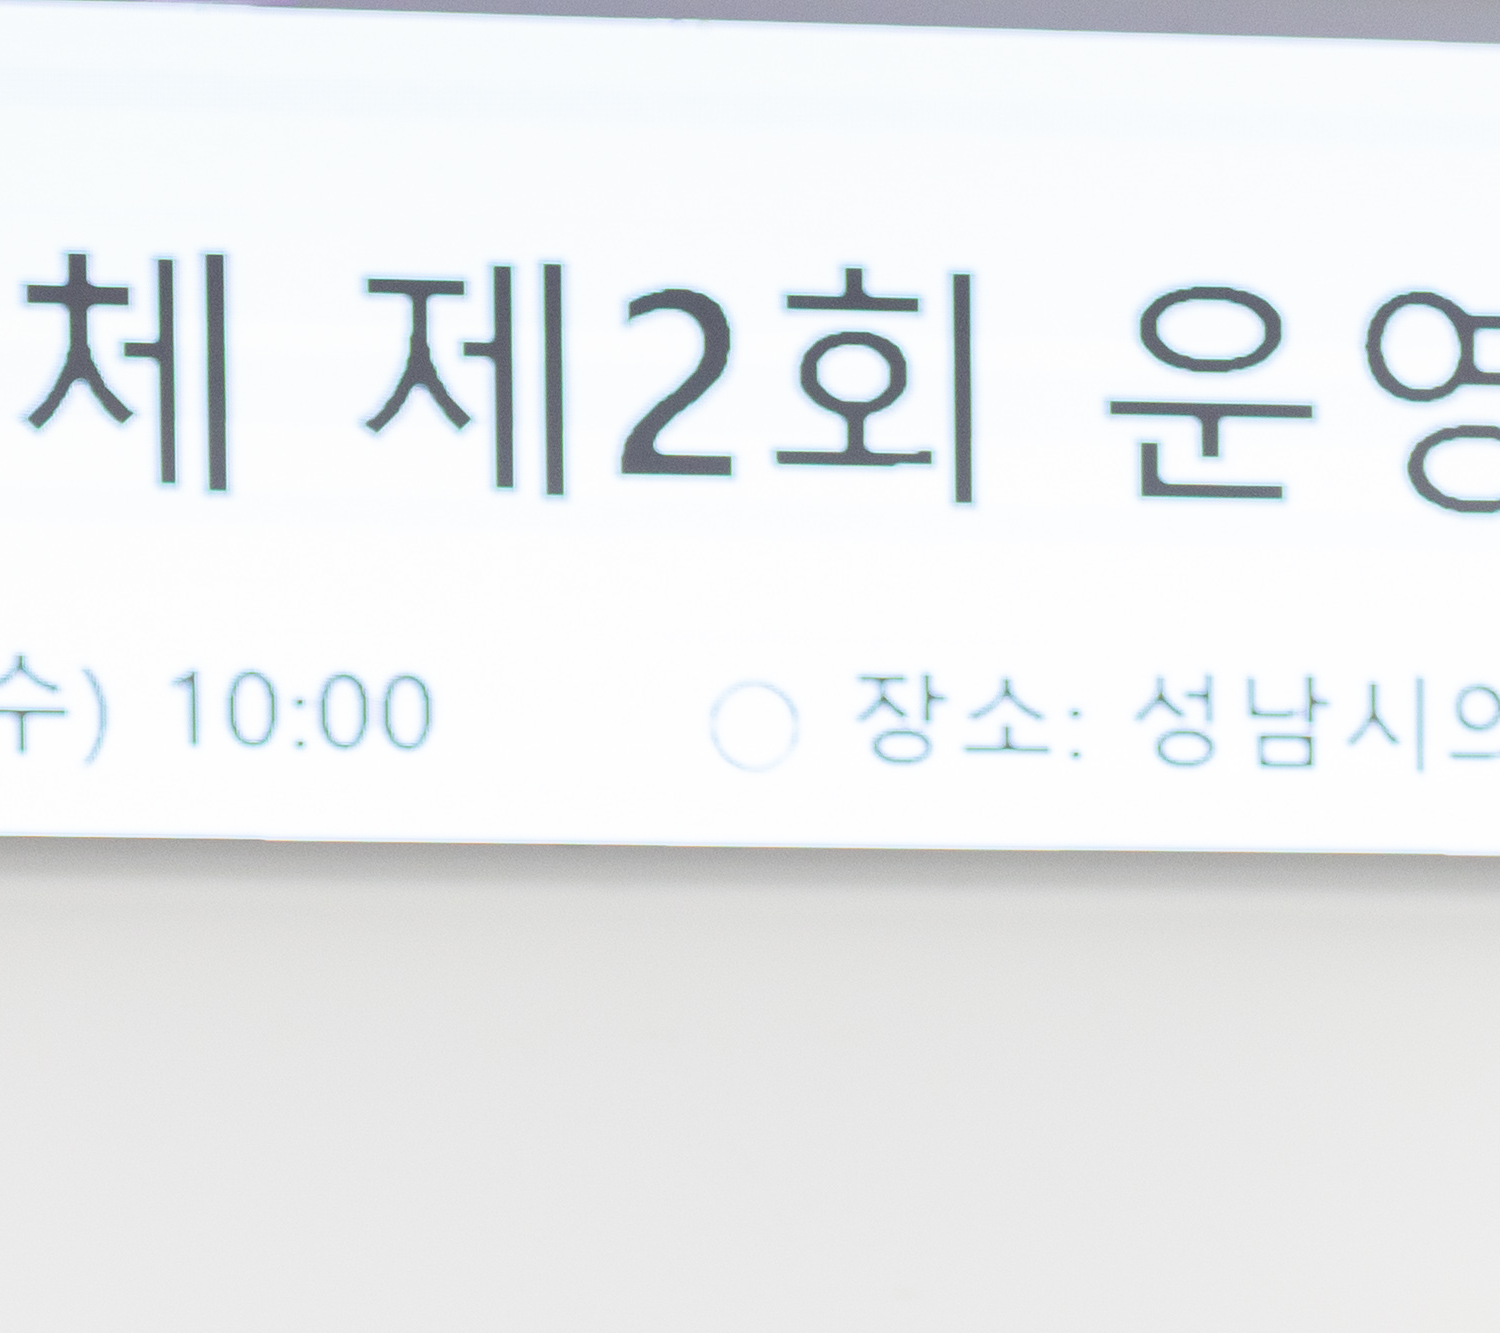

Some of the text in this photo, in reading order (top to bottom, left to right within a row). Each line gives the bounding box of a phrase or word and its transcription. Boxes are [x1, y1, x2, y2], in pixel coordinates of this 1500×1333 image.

[361, 260, 976, 506] 제2회
[169, 667, 435, 753] 10:00
[855, 670, 1083, 767] 장소:
